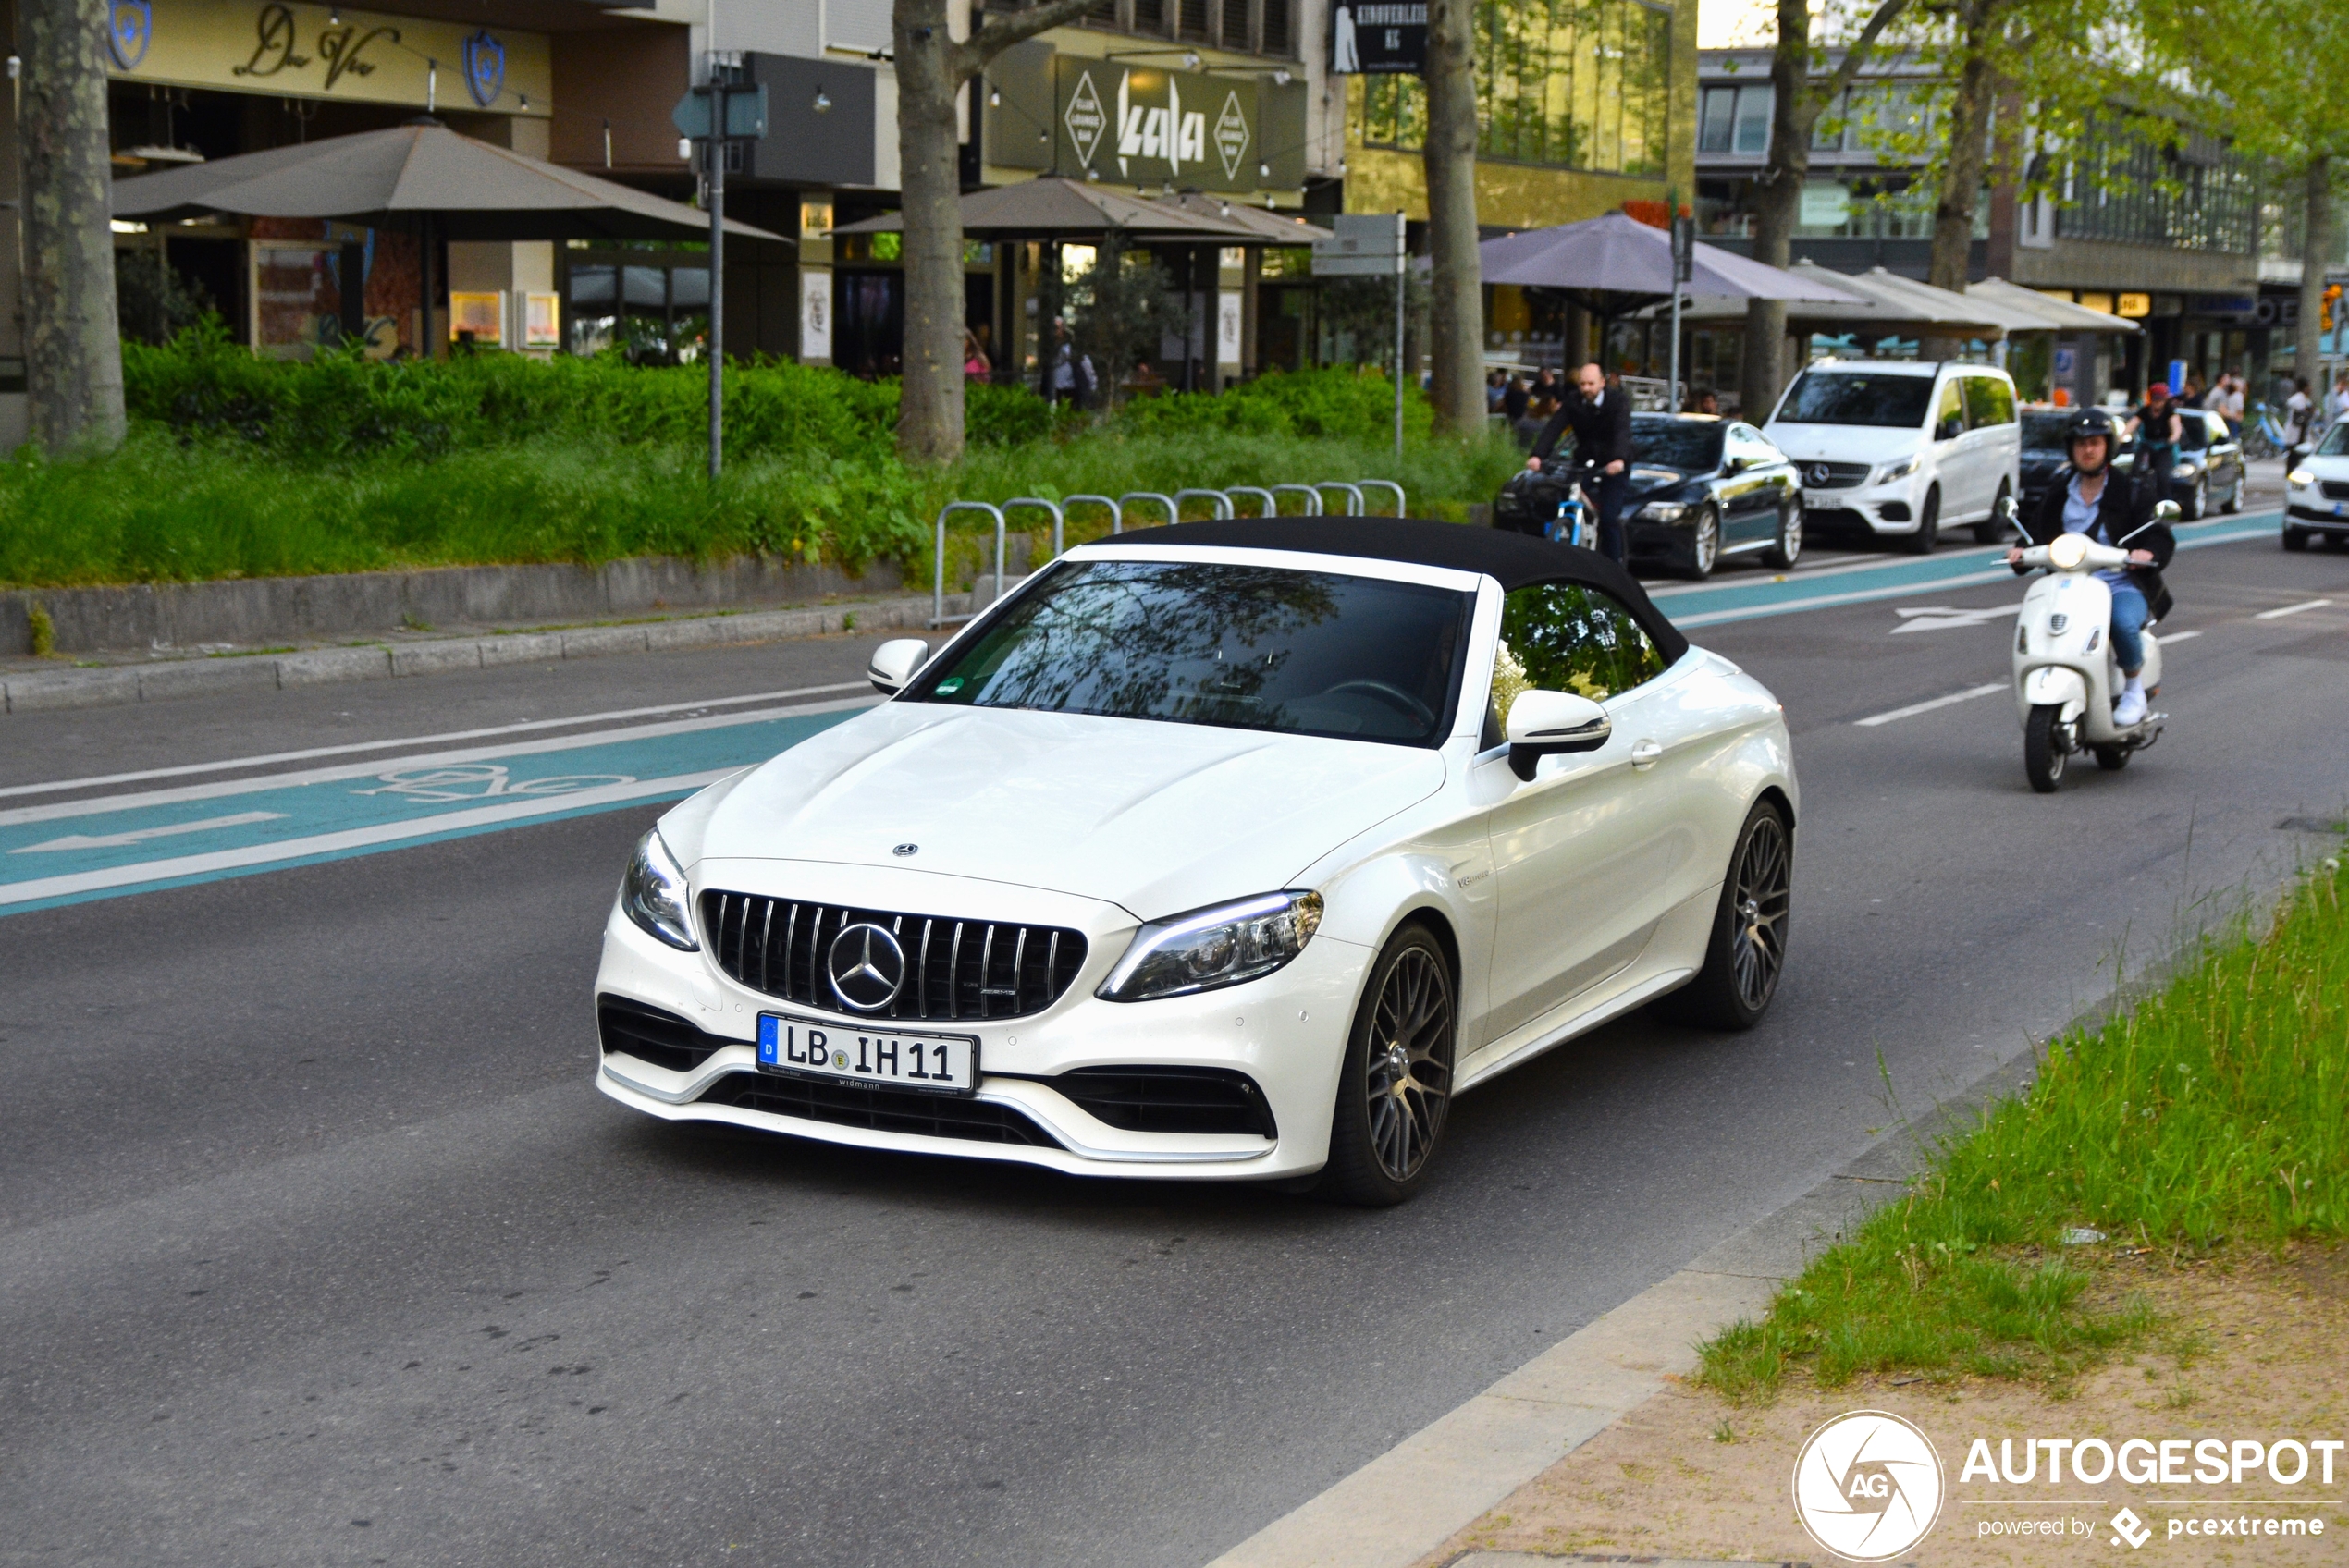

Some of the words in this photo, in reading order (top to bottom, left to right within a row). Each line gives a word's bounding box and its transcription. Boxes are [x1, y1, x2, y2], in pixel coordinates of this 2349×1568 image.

[1070, 114, 1100, 128] LOUNGE
[765, 1044, 773, 1056] D
[787, 1025, 829, 1066] LB
[838, 1078, 880, 1091] widmann
